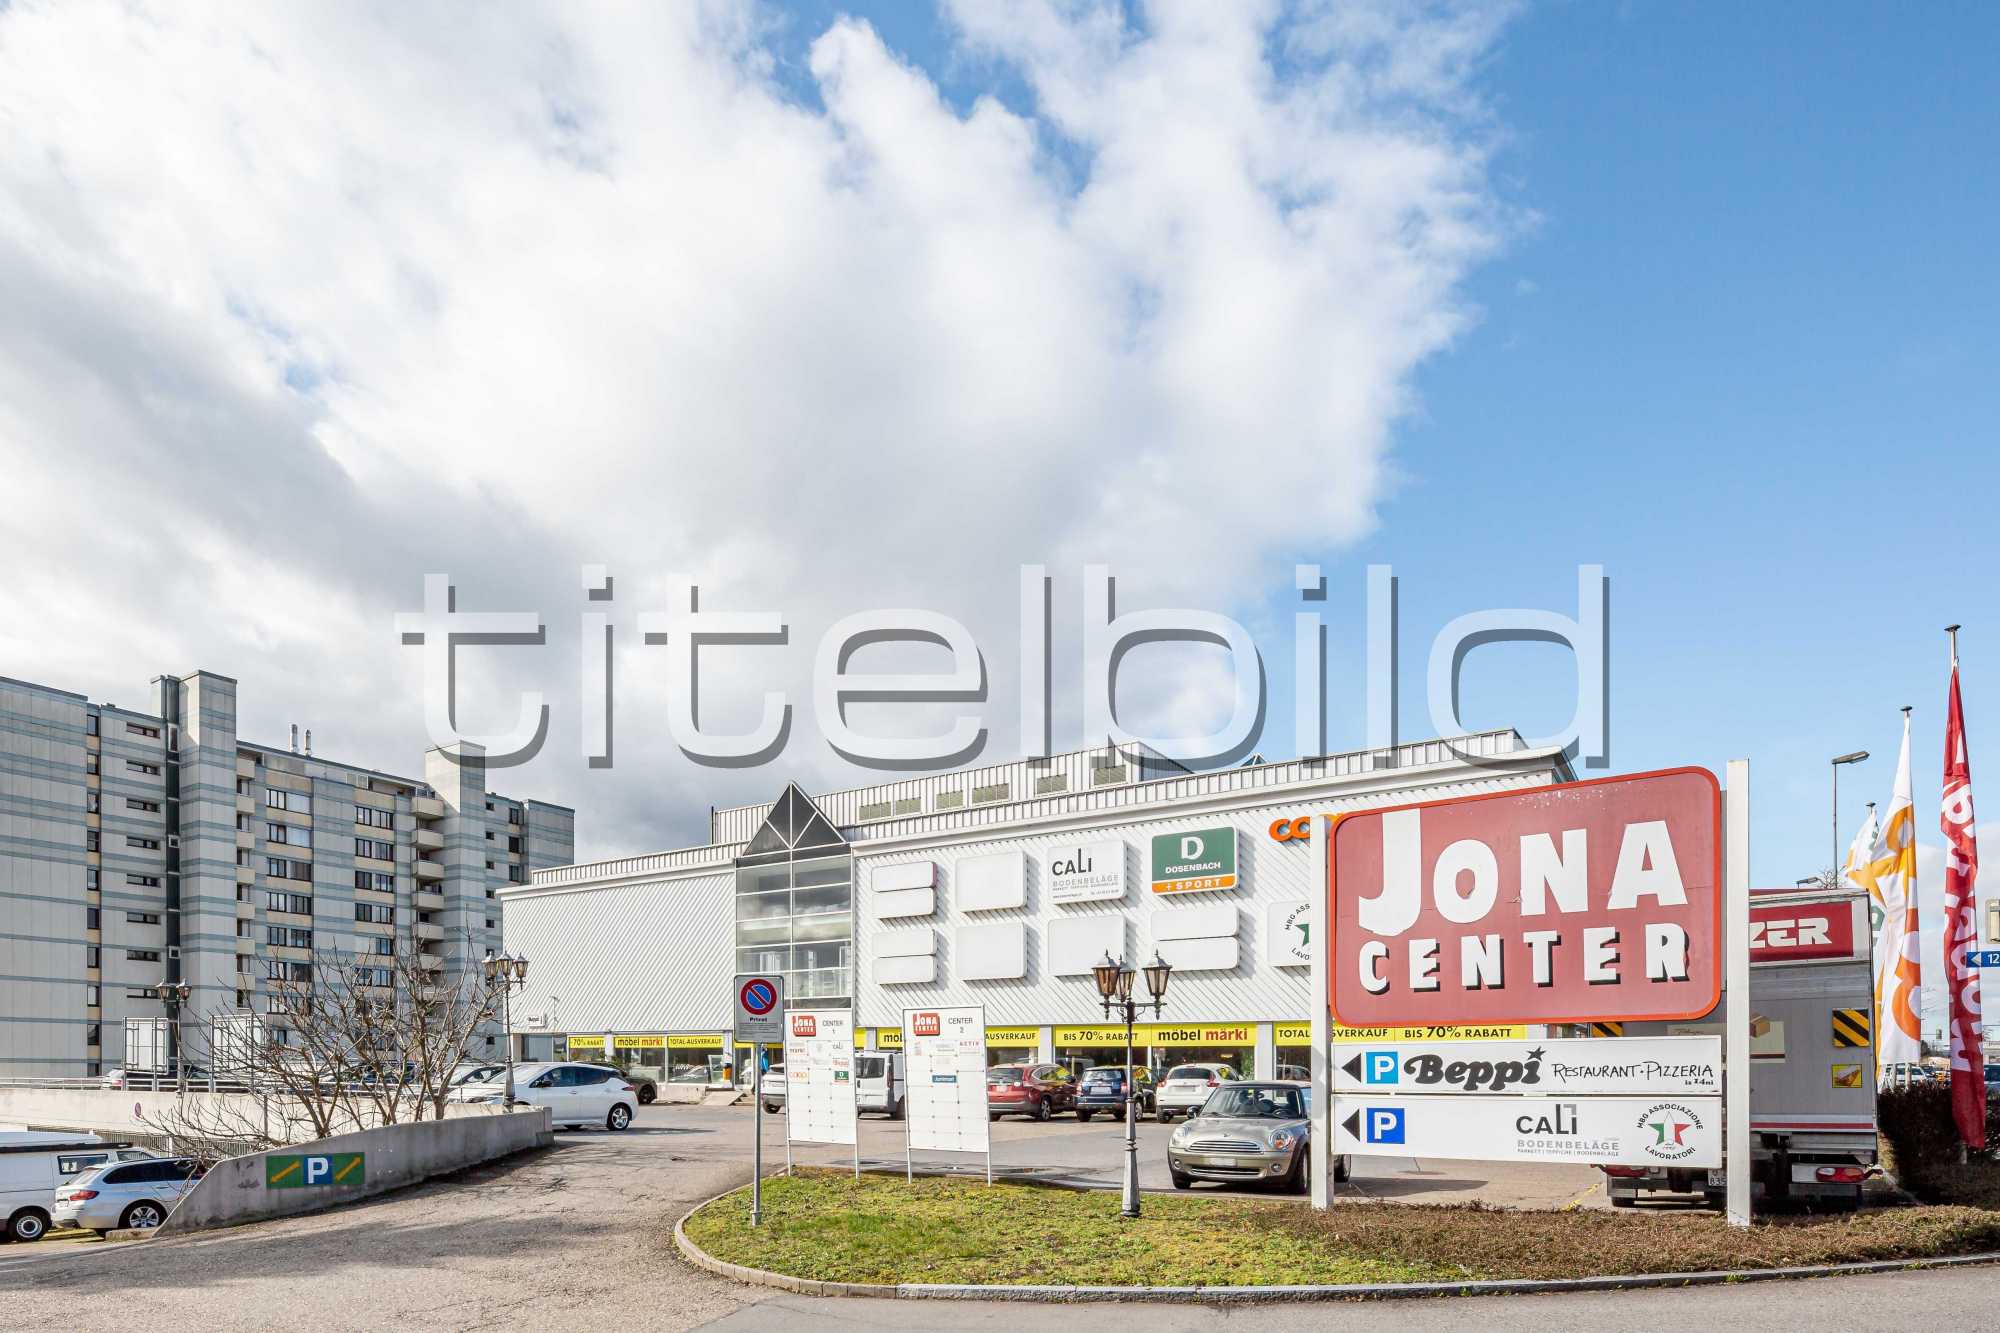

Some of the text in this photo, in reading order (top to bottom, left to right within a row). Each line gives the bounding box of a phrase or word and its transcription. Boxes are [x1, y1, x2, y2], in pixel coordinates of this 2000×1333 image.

[1181, 836, 1204, 860] D
[1165, 861, 1221, 874] DOSENBACH
[1359, 808, 1688, 936] JONA
[1176, 879, 1221, 890] SPORT
[1750, 917, 1832, 949] ZER
[1359, 923, 1690, 995] CENTER
[948, 1017, 973, 1025] CENTER
[986, 1032, 1037, 1041] AUSVERKAUF
[1063, 1033, 1077, 1041] BIS
[1079, 1031, 1104, 1041] 70%
[1158, 1028, 1248, 1041] möbel märki
[1404, 1026, 1512, 1038] BIS 70% RABATT
[1374, 1055, 1395, 1080] P
[1403, 1046, 1546, 1091] Beppi
[1374, 1112, 1397, 1139] P
[1637, 1103, 1704, 1130] MBG ASSOCIAZIONE
[1645, 1145, 1696, 1160] LAVORATORI
[307, 1157, 329, 1184] P
